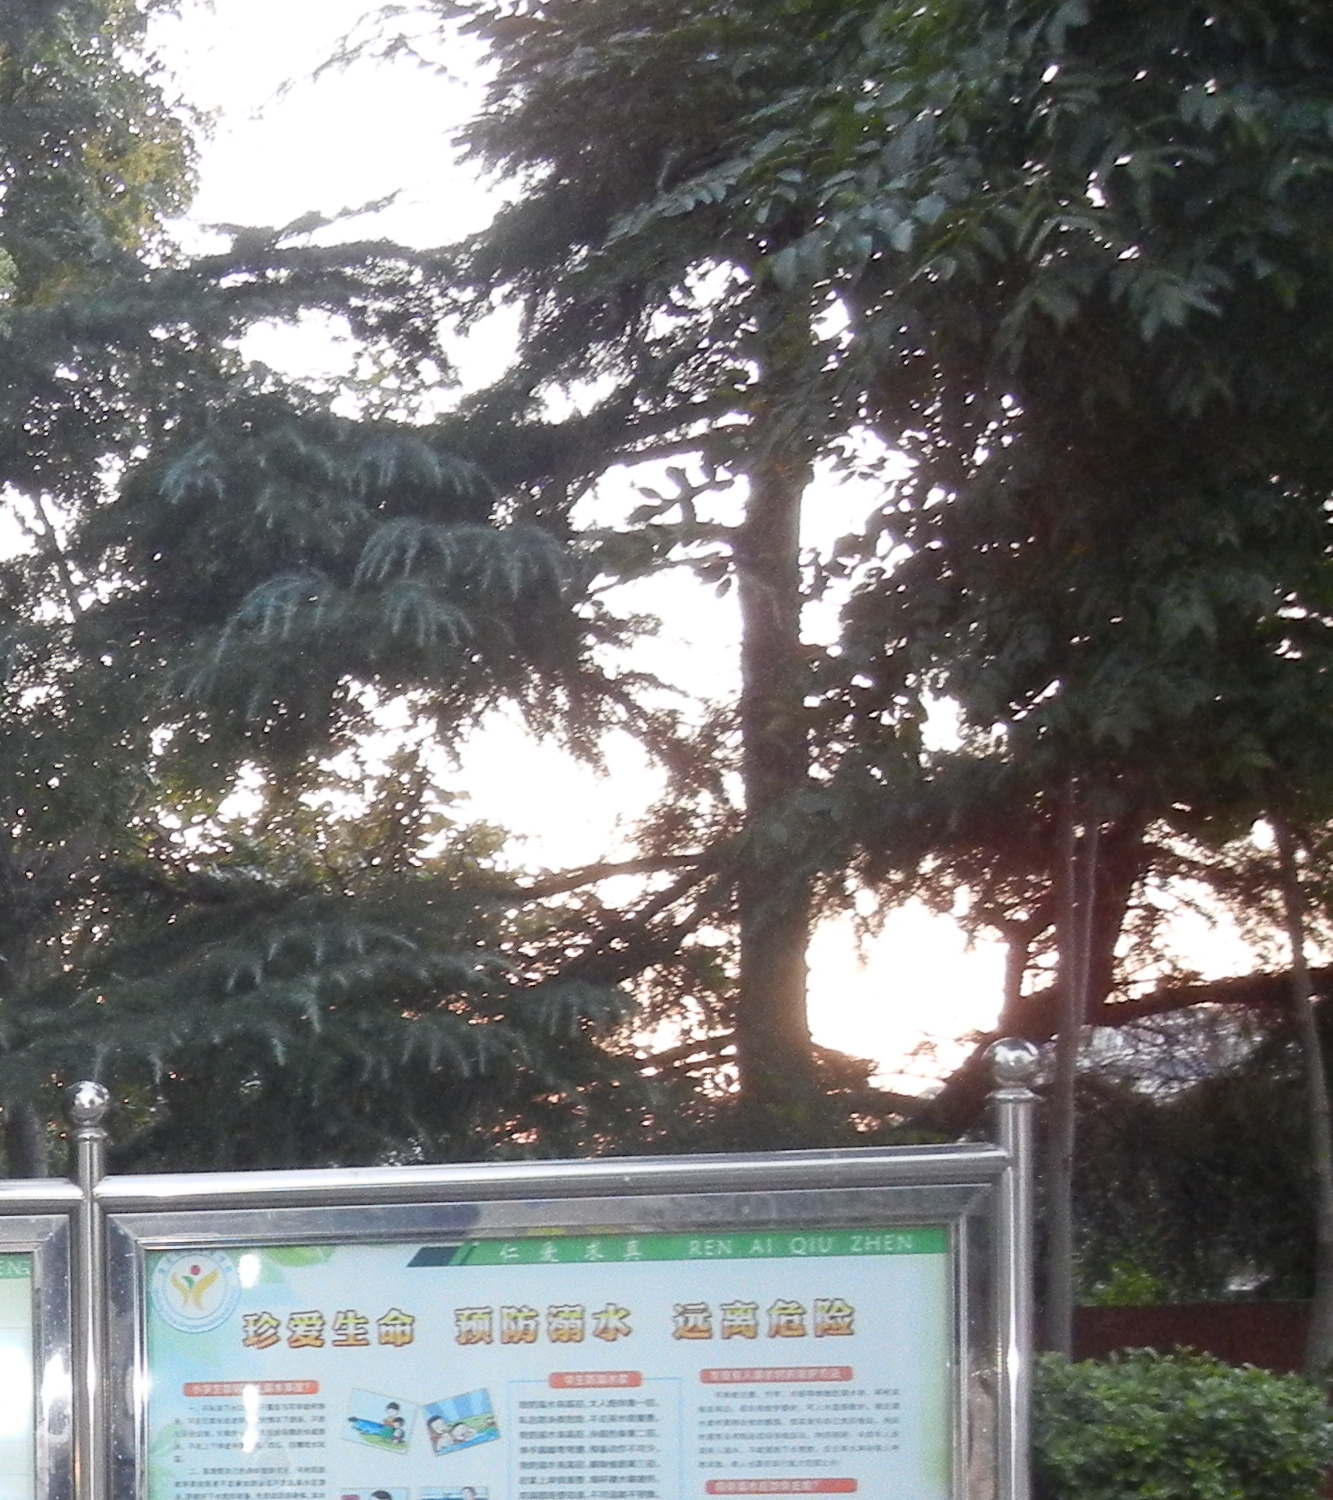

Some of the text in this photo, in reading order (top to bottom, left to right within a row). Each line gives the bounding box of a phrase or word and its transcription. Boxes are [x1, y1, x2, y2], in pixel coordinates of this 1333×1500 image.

[689, 1234, 913, 1256] REN AI QIU ZHEN
[242, 1298, 855, 1349] 珍爱生命 预防溺水 远离危险
